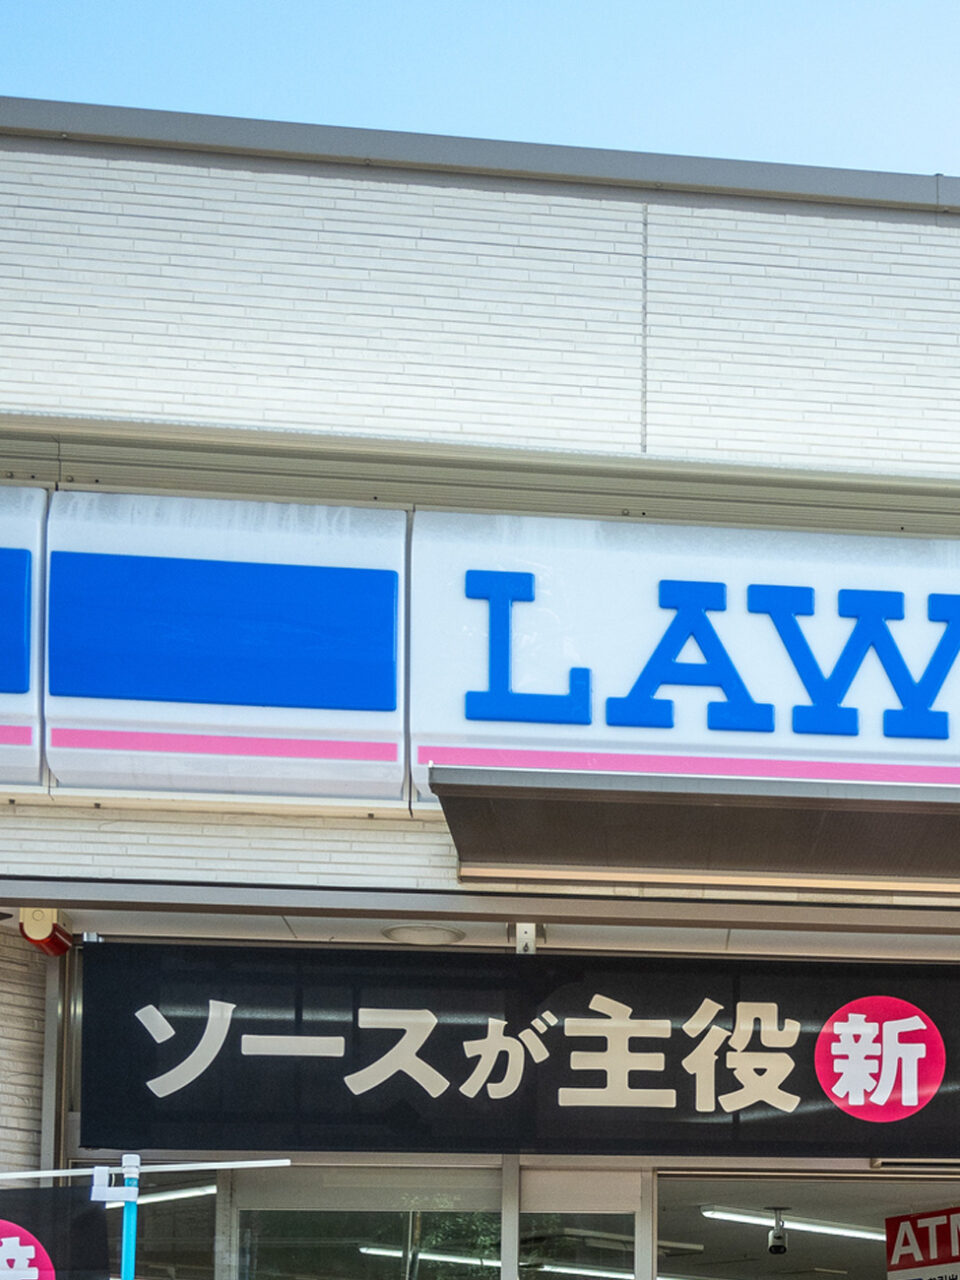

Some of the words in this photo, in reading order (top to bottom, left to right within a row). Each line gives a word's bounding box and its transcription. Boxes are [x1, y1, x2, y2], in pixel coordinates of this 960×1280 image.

[134, 993, 802, 1113] ソースが主役
[830, 1012, 928, 1107] 新
